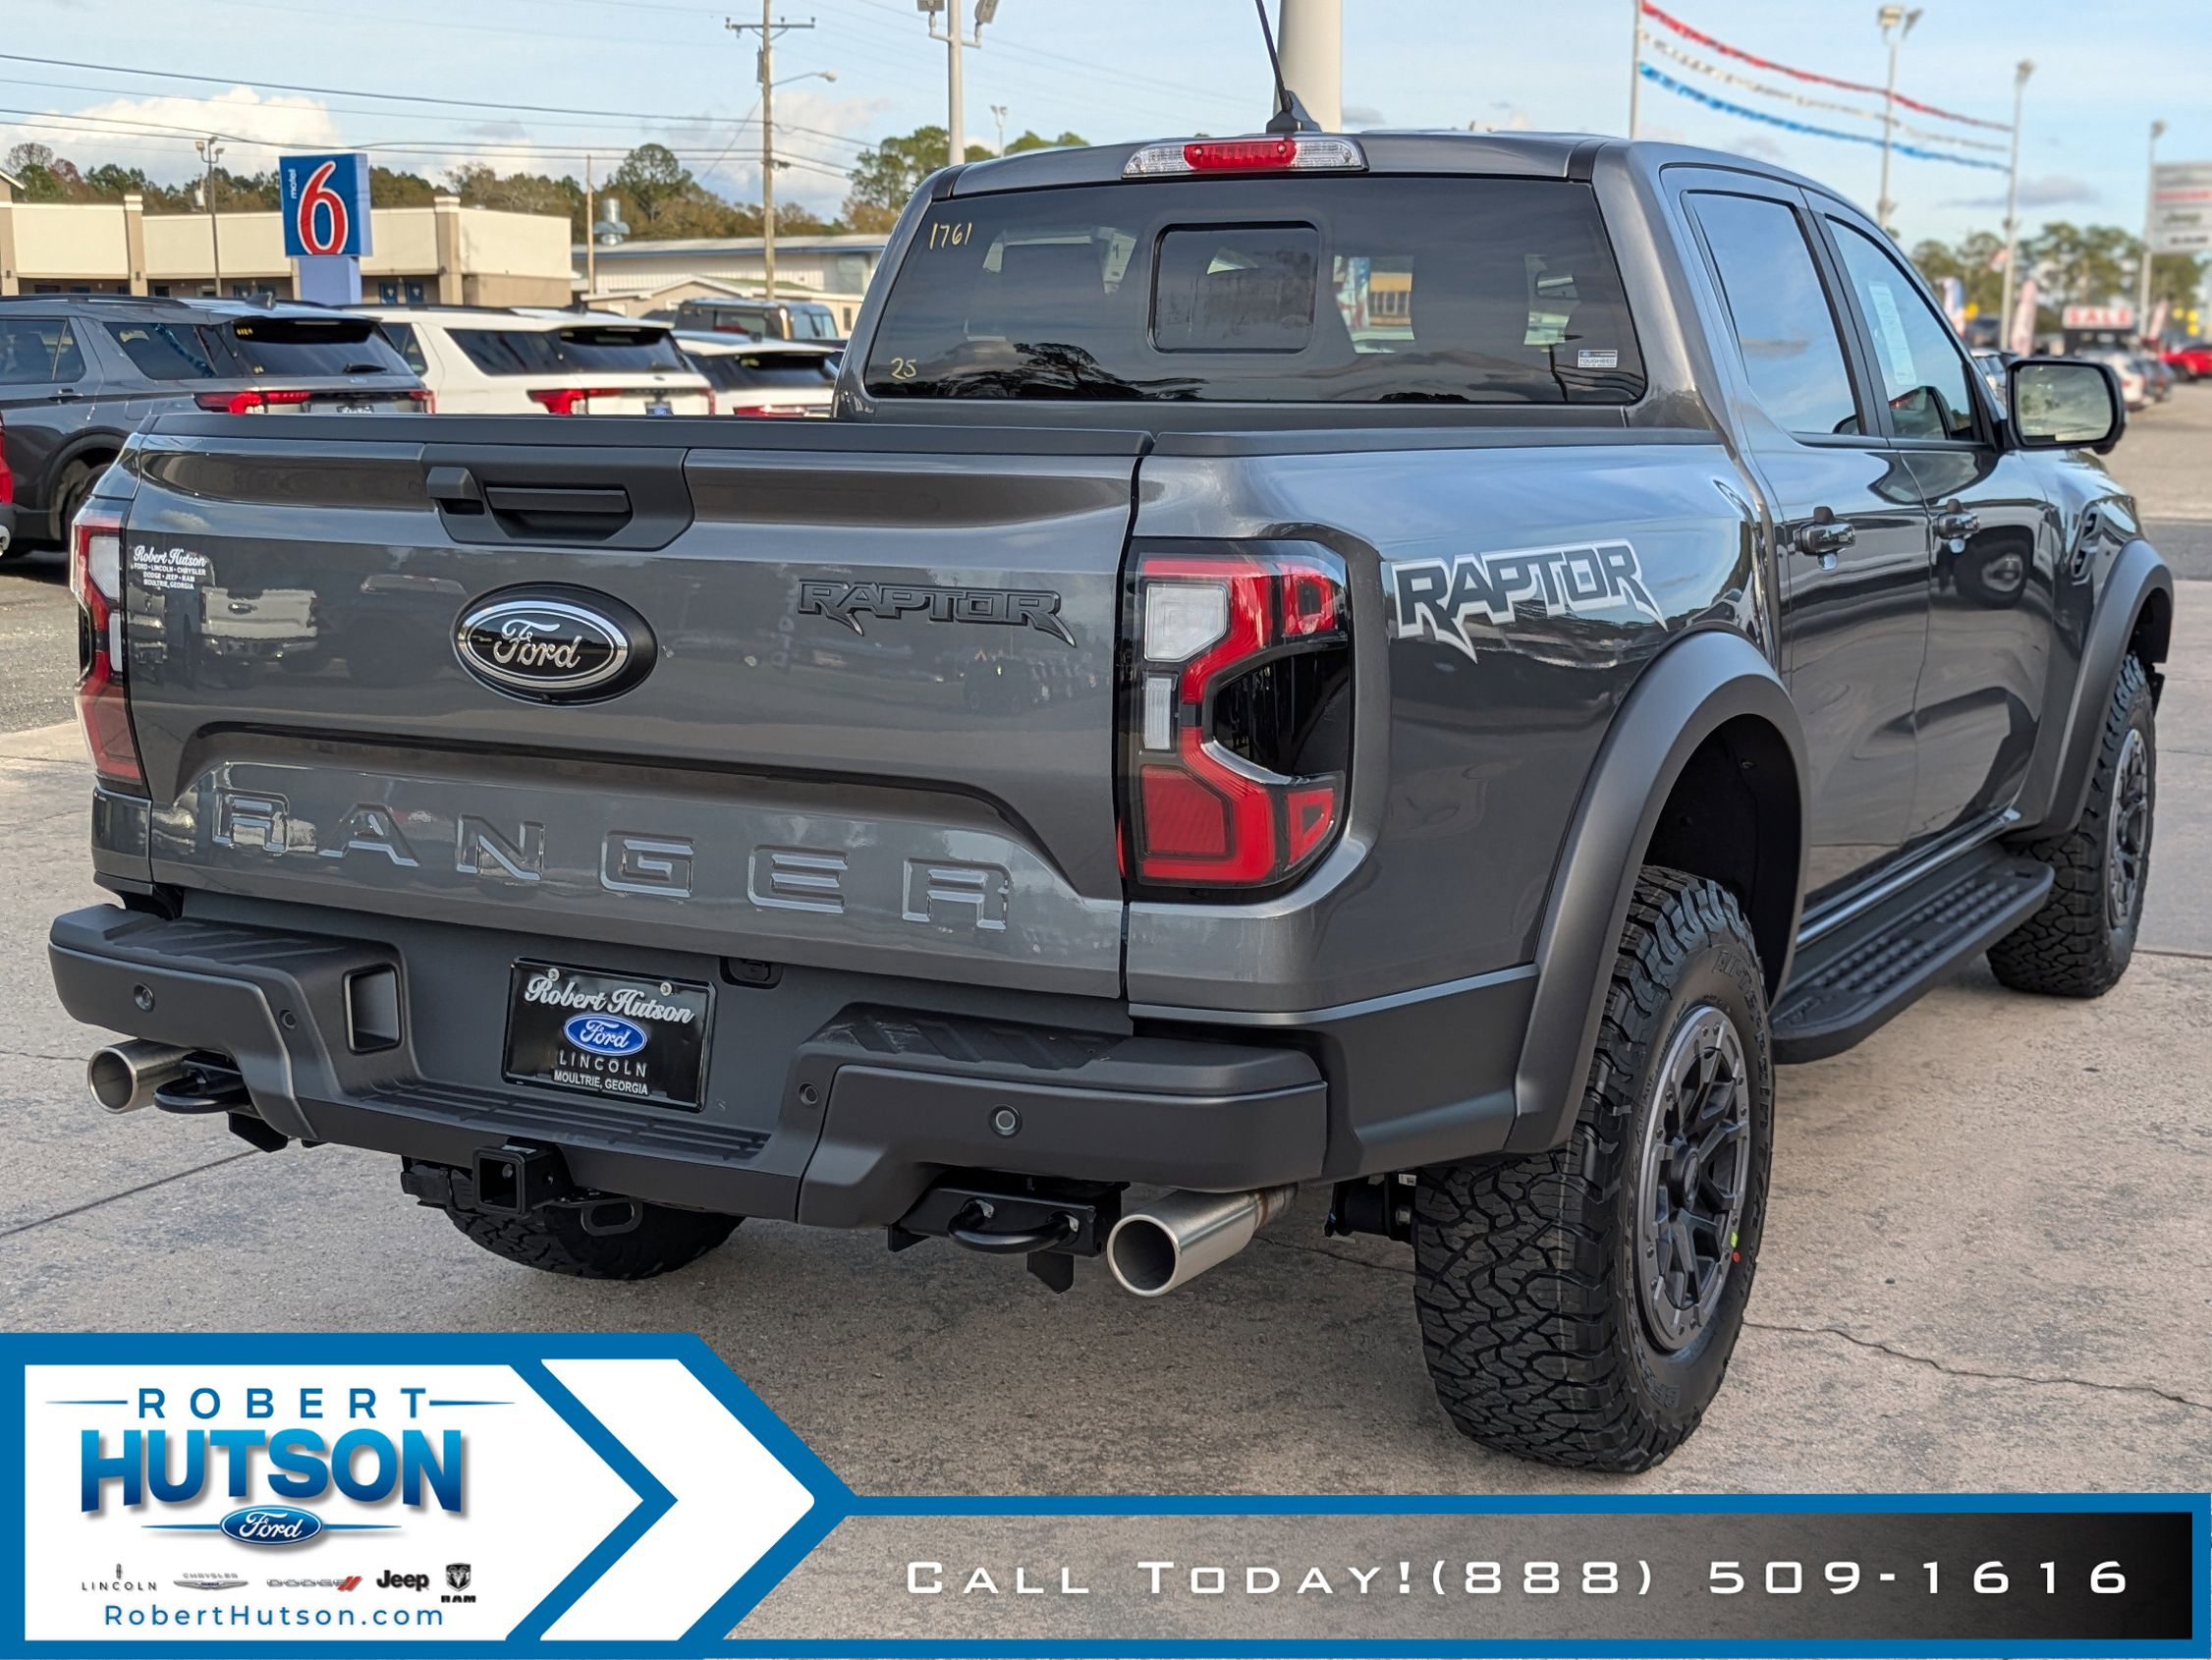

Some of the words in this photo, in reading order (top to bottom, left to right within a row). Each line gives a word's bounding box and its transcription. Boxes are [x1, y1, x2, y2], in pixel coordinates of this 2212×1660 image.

[288, 168, 298, 199] motel
[297, 159, 350, 255] 6
[929, 222, 973, 250] 1761
[2069, 306, 2129, 327] SALE
[890, 357, 917, 381] 25
[134, 544, 168, 565] Robert
[168, 547, 208, 568] Hutson
[151, 564, 175, 573] LINCOLN
[177, 566, 206, 577] CHRYSLER
[797, 578, 1078, 649] RAPTOR
[1391, 537, 1670, 666] RAPTOR
[492, 618, 582, 669] Ford
[210, 785, 1010, 931] RANGER
[524, 975, 610, 1013] Robert
[606, 988, 695, 1024] Hutson
[580, 1019, 631, 1049] Ford
[558, 1050, 648, 1079] LINCOLN
[553, 1070, 603, 1090] MOULTRIE,
[604, 1079, 649, 1096] GEORGIA
